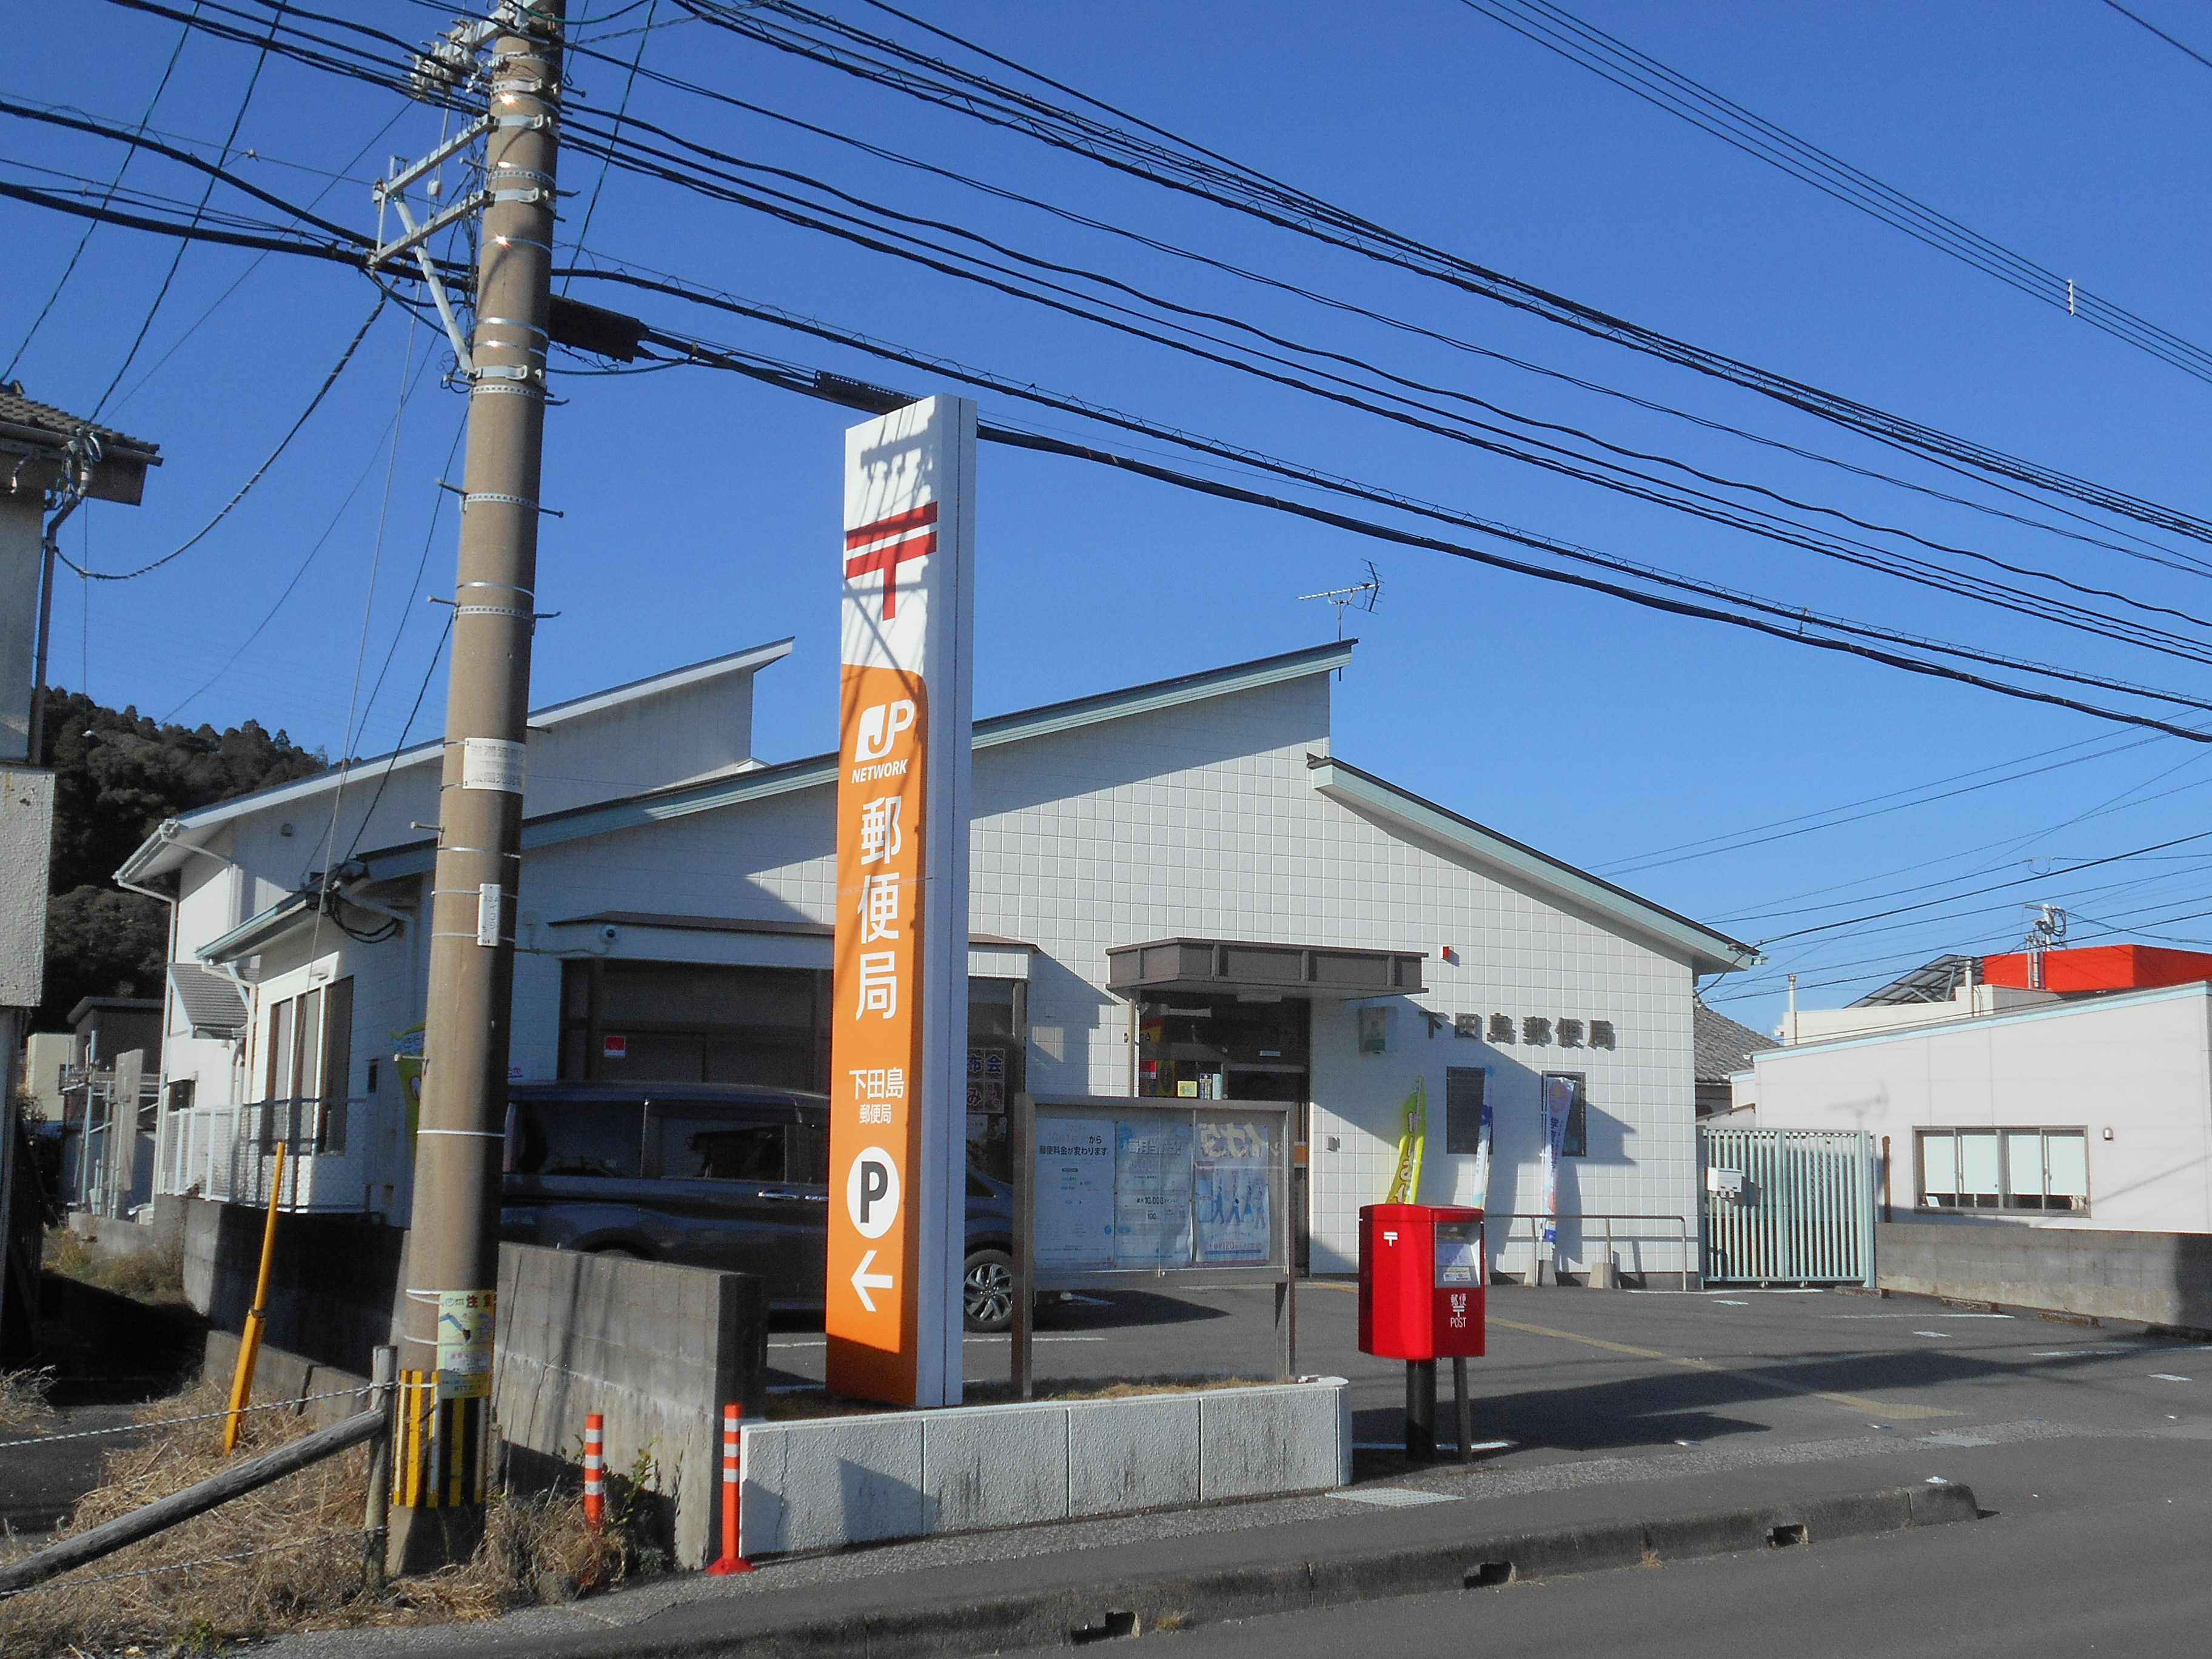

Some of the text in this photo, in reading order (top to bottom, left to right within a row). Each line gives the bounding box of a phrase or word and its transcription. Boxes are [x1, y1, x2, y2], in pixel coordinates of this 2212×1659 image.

[854, 699, 914, 763] JP
[851, 759, 908, 784] NETWORK
[856, 795, 902, 1021] 郵便局
[1419, 1010, 1616, 1051] 下田島郵便局
[849, 1067, 904, 1100] 下田島
[859, 1104, 892, 1125] 郵便局
[859, 1161, 888, 1224] P
[1450, 1293, 1467, 1306] 郵便
[1450, 1317, 1467, 1328] POST
